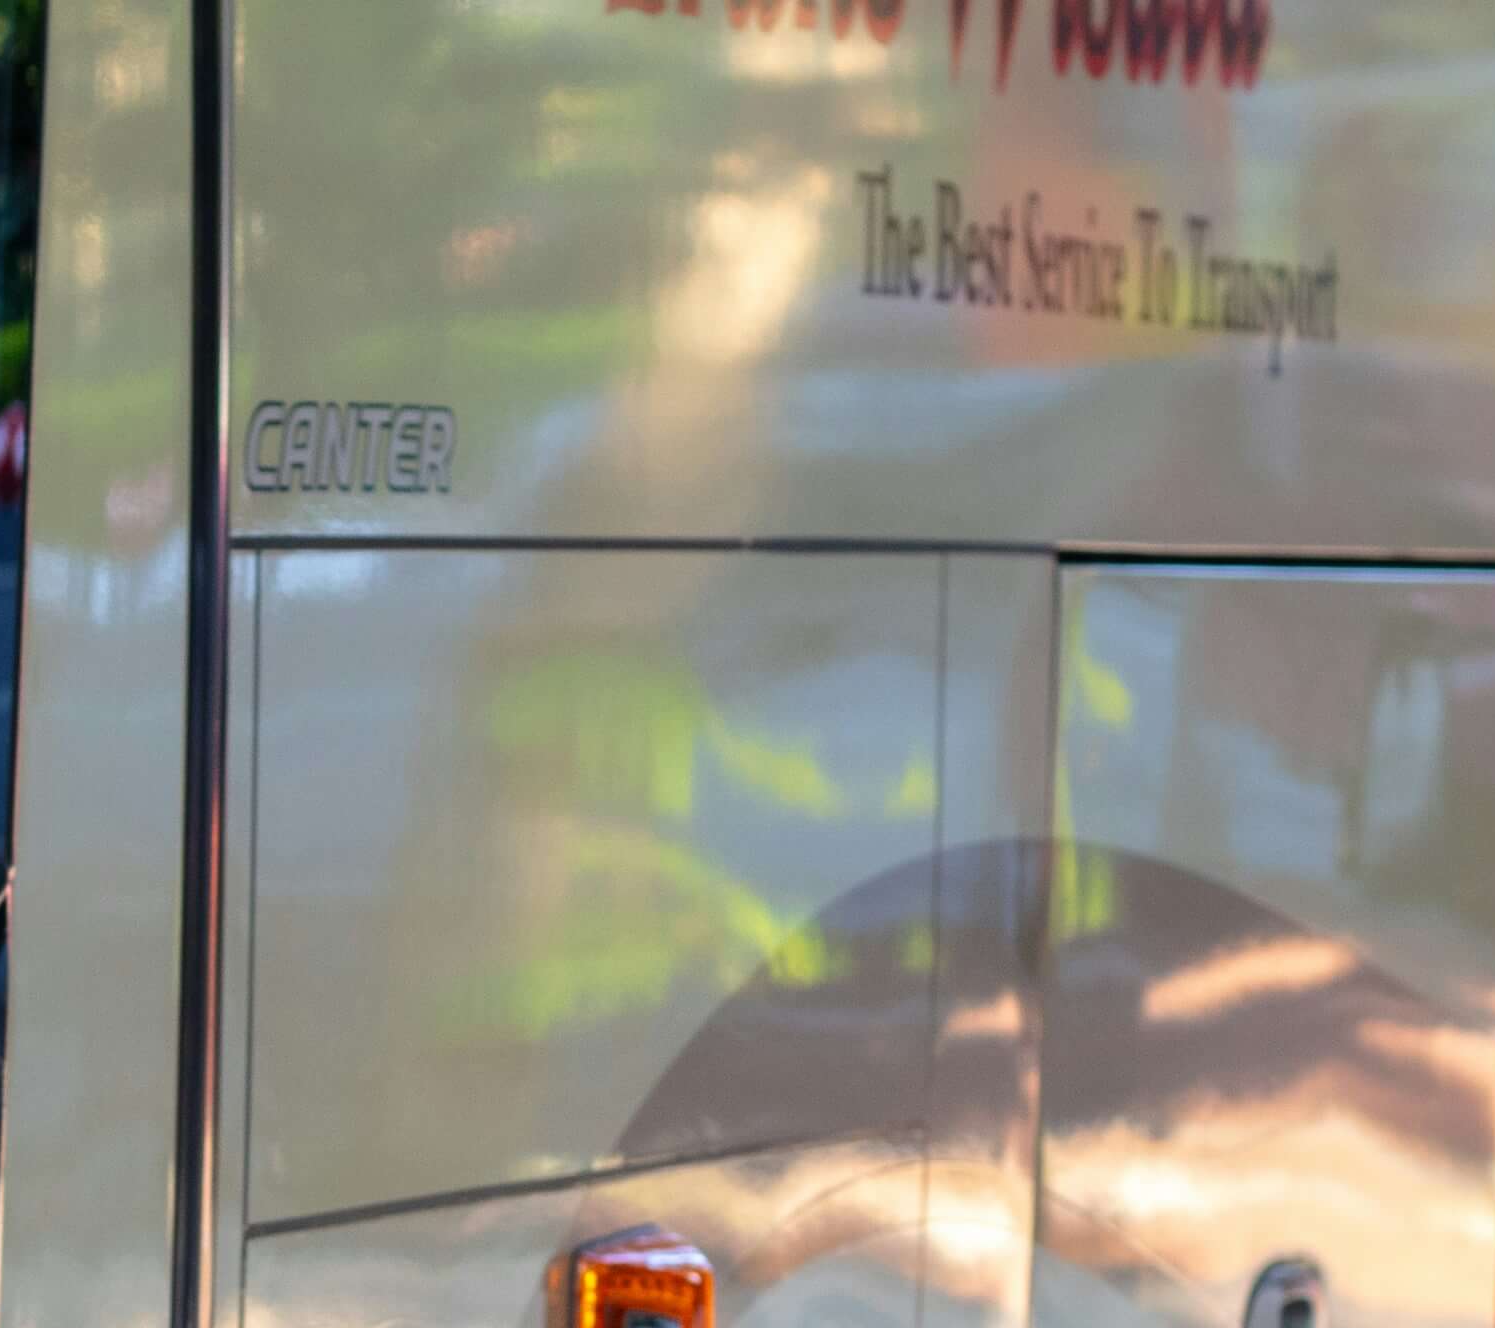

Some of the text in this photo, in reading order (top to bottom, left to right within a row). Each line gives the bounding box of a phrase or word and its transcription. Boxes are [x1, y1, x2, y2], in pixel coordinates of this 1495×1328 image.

[855, 163, 1339, 380] The Best Service To Transport
[245, 399, 457, 493] CANTER
